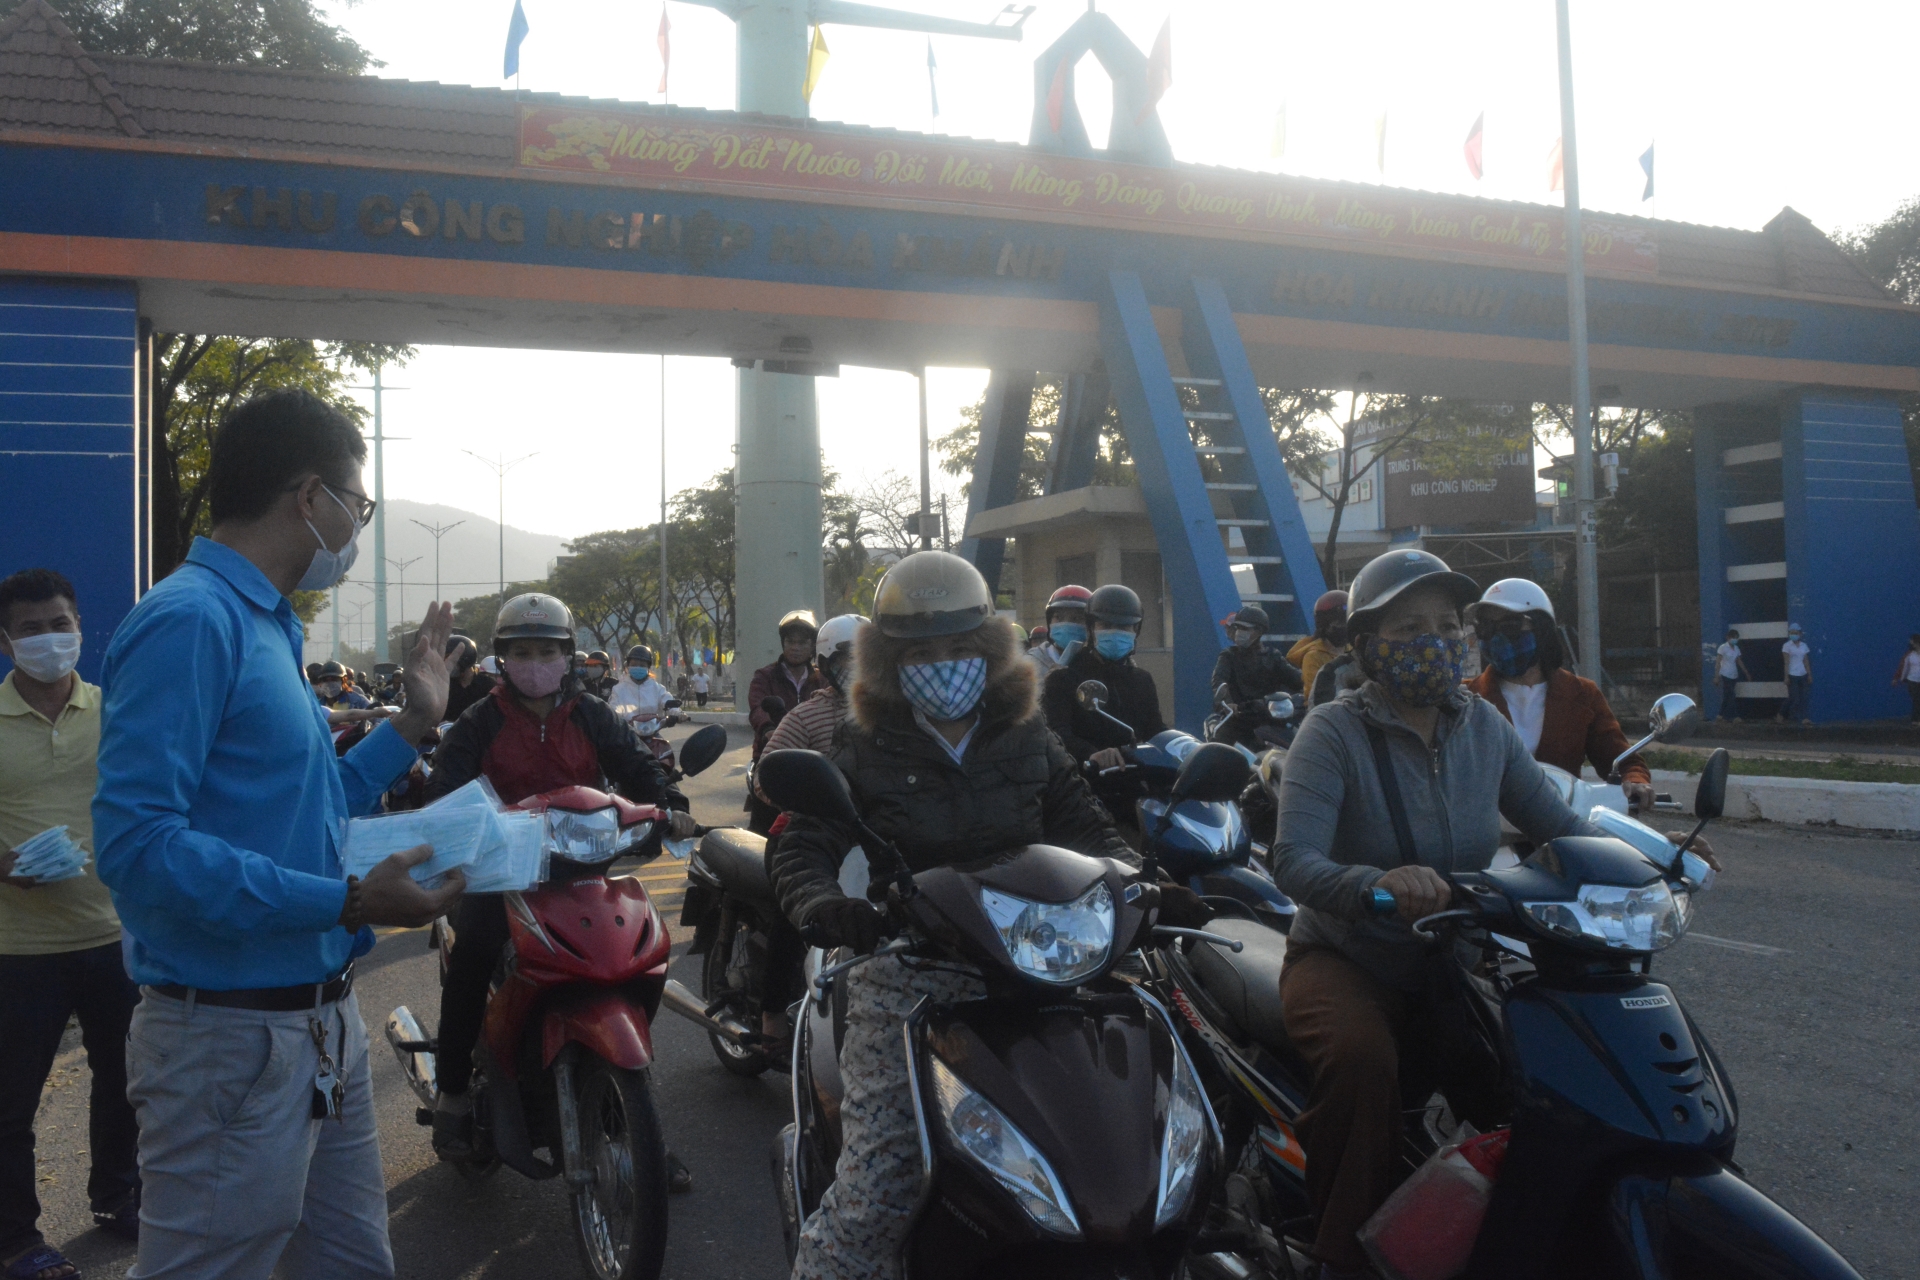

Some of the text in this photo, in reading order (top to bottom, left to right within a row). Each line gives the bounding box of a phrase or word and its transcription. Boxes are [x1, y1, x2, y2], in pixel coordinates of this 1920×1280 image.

[610, 124, 701, 173] Mừng
[712, 134, 777, 170] Đất
[782, 140, 862, 177] Nước
[874, 150, 928, 184] Đổi
[1010, 162, 1084, 206] Mừng
[1094, 172, 1166, 215] Đảng
[1176, 181, 1255, 224] Quang
[1333, 200, 1398, 238] Mừng
[1405, 206, 1461, 238] Xuân
[1470, 214, 1524, 246] Canh
[205, 183, 337, 234] KHU
[357, 188, 525, 246] CÔNG
[768, 216, 875, 273] HÒA
[1388, 459, 1410, 474] TRUNG
[1411, 482, 1429, 496] KHU
[1431, 478, 1459, 494] CÔNG
[1172, 988, 1204, 1031] Wave
[1624, 998, 1668, 1007] HONDA
[942, 1197, 988, 1239] HONDA
